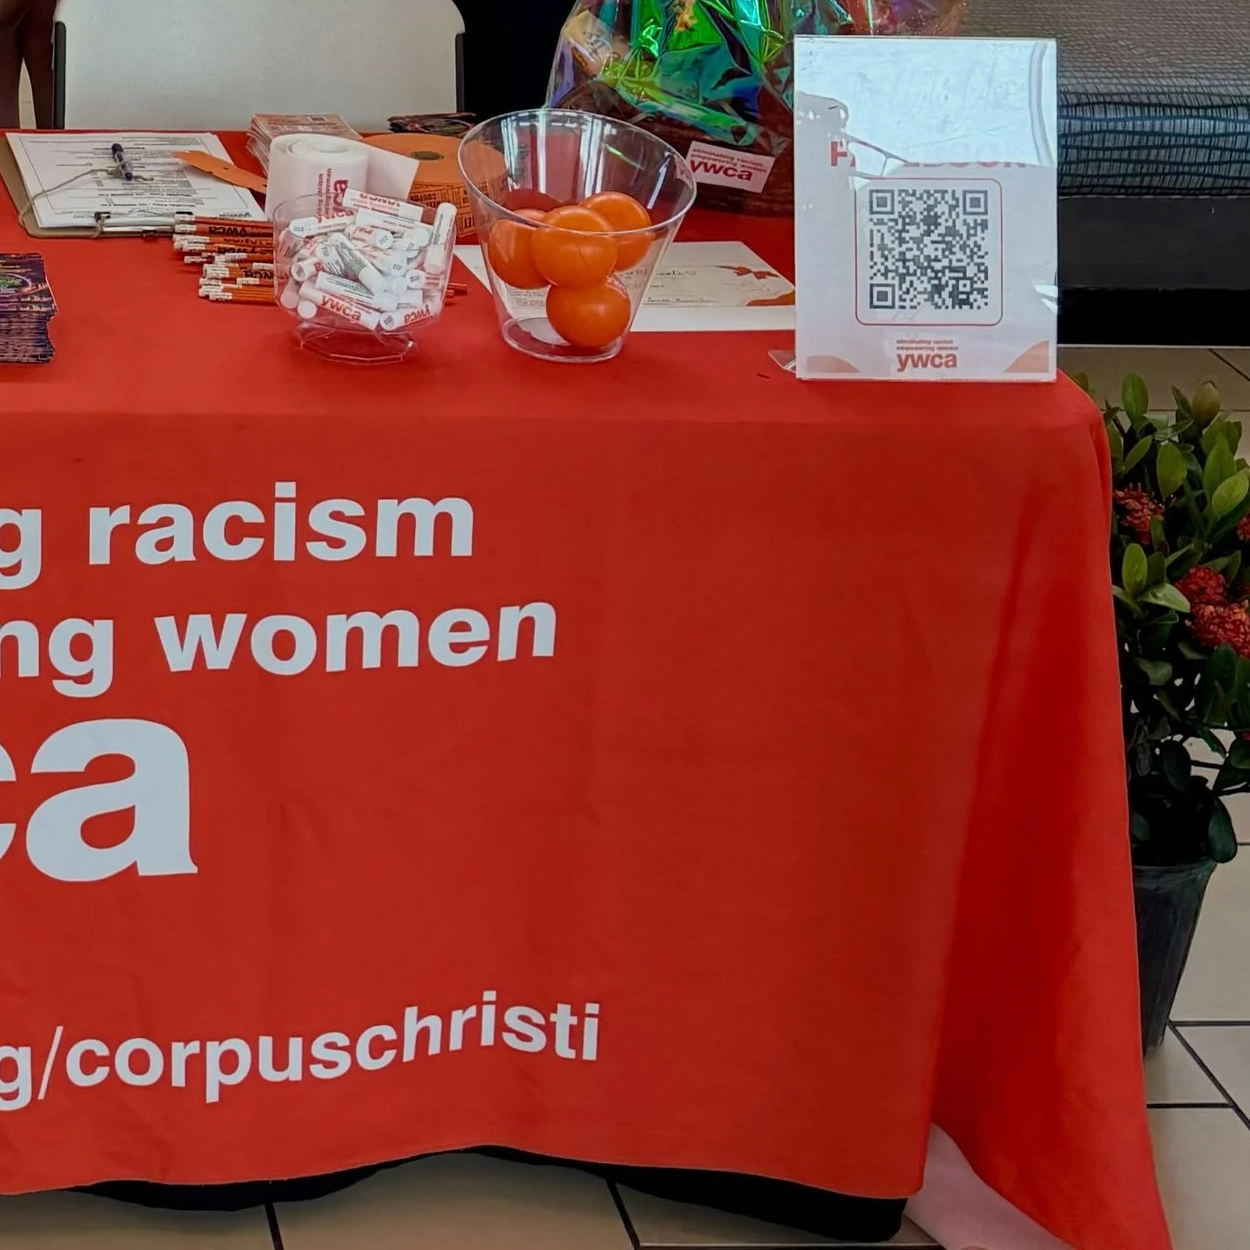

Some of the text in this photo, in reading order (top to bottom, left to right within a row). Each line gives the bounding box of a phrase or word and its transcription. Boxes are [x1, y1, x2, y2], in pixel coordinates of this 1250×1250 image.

[690, 160, 754, 181] ywca
[322, 295, 361, 321] ywca
[404, 304, 430, 323] ywca
[896, 353, 957, 372] ywca
[90, 482, 473, 564] racism
[155, 602, 556, 675] women
